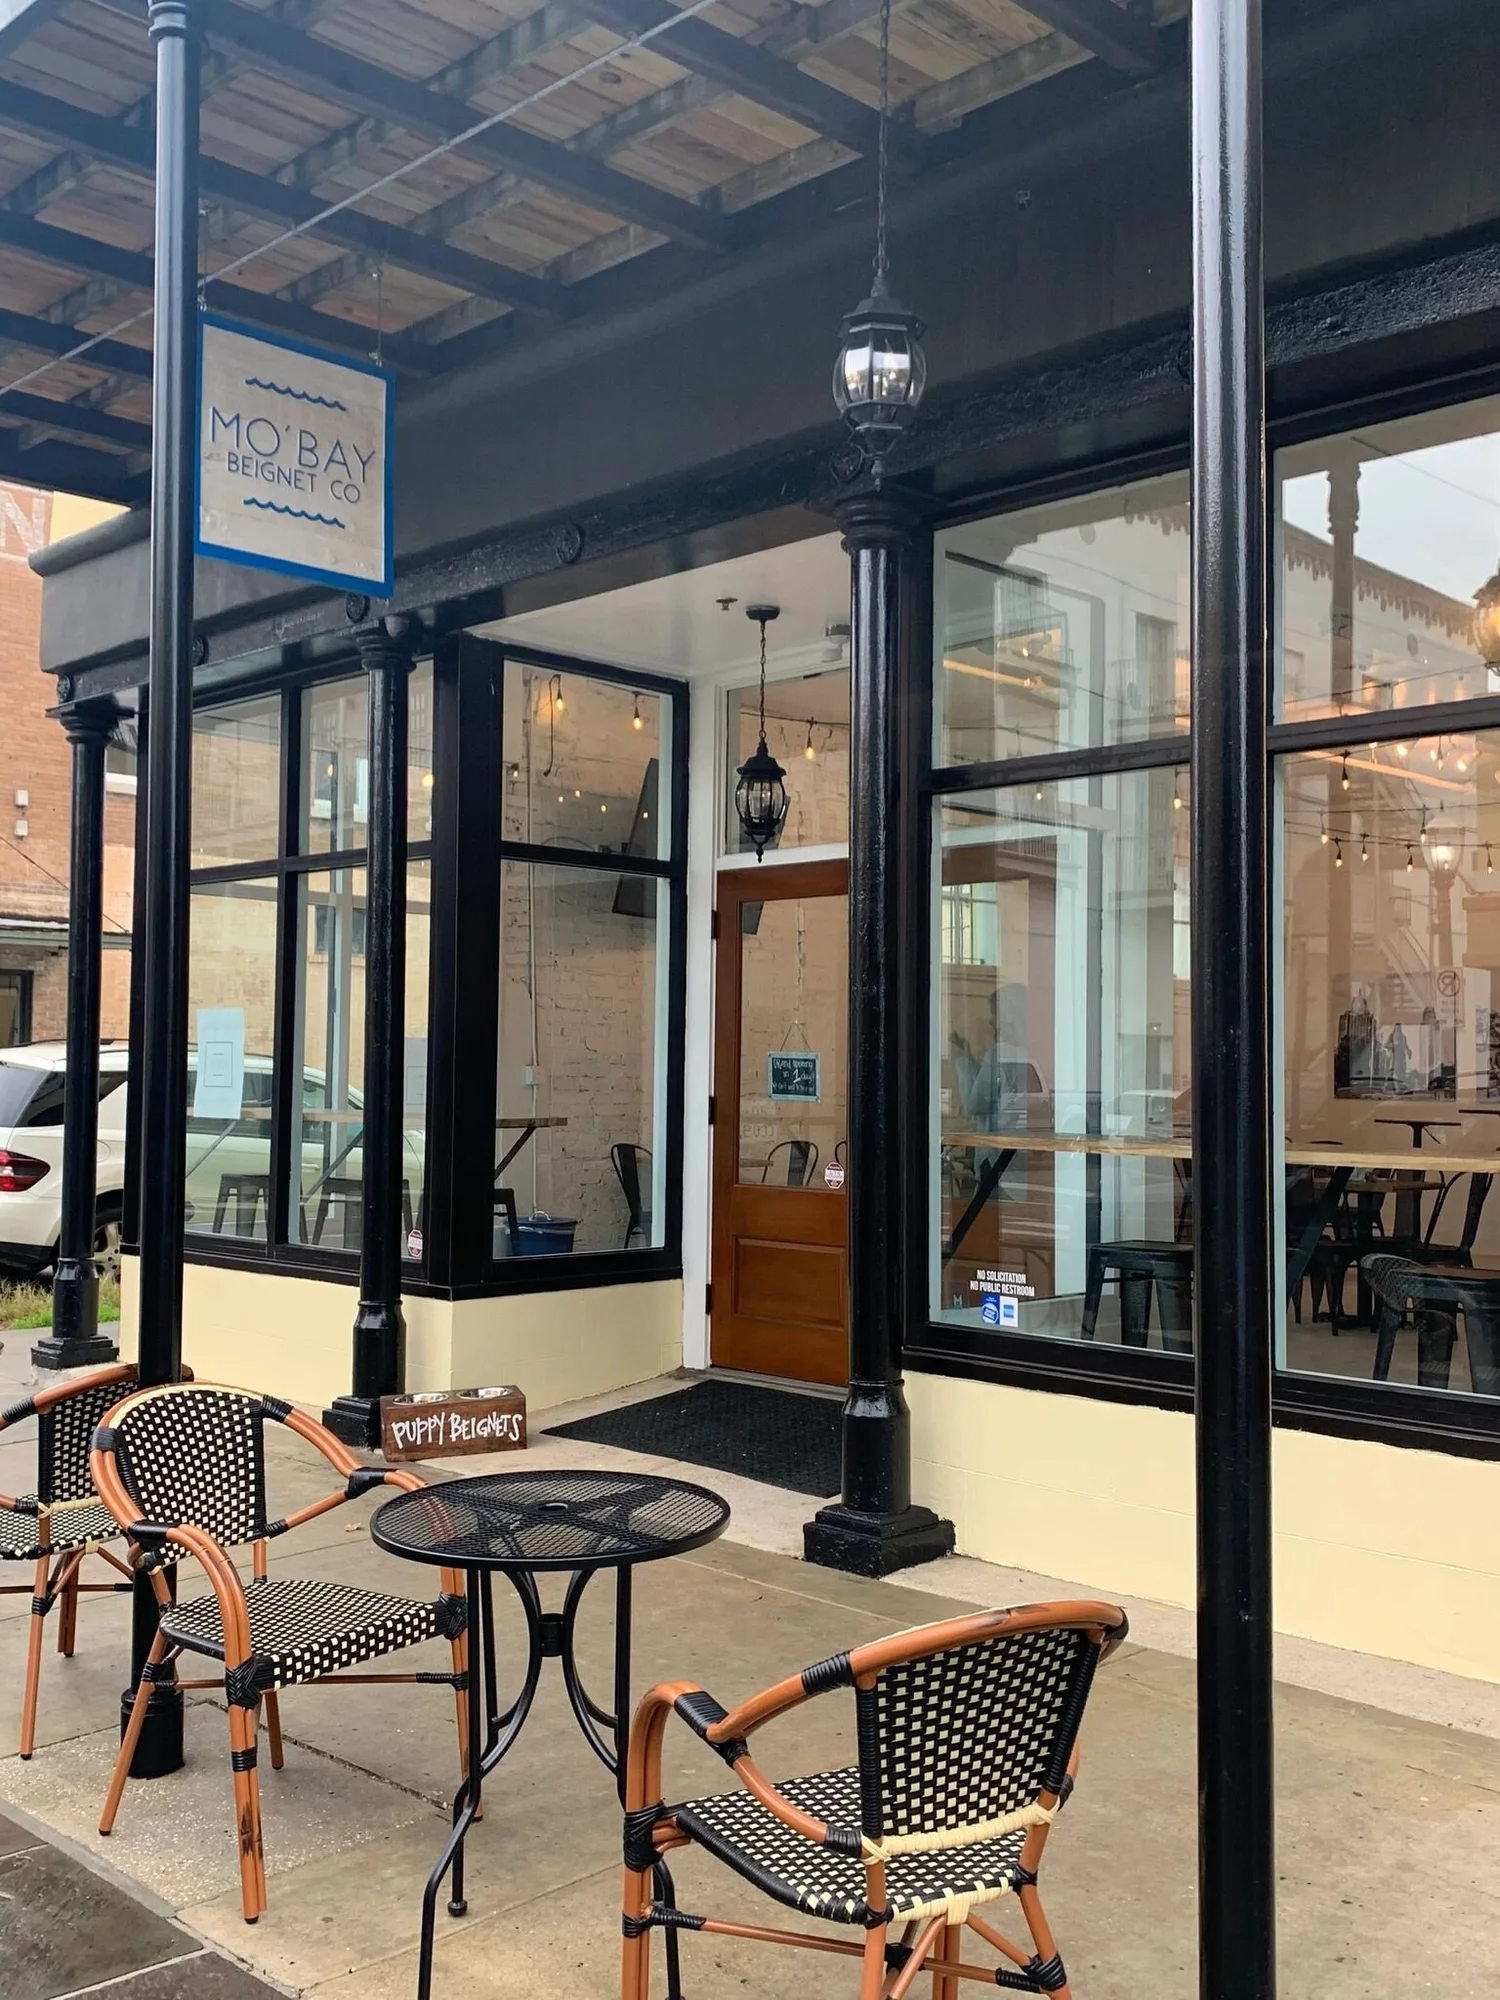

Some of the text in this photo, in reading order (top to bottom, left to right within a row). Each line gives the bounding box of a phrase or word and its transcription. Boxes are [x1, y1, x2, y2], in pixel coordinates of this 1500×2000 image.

[209, 405, 376, 484] MO'BAY
[227, 451, 361, 504] BEIGNET CO
[969, 1280, 1035, 1297] NO PUBLIC RESTROOM
[976, 1269, 1026, 1284] NO SOLICITATION
[391, 1411, 523, 1449] PUPPY BEIGNETS
